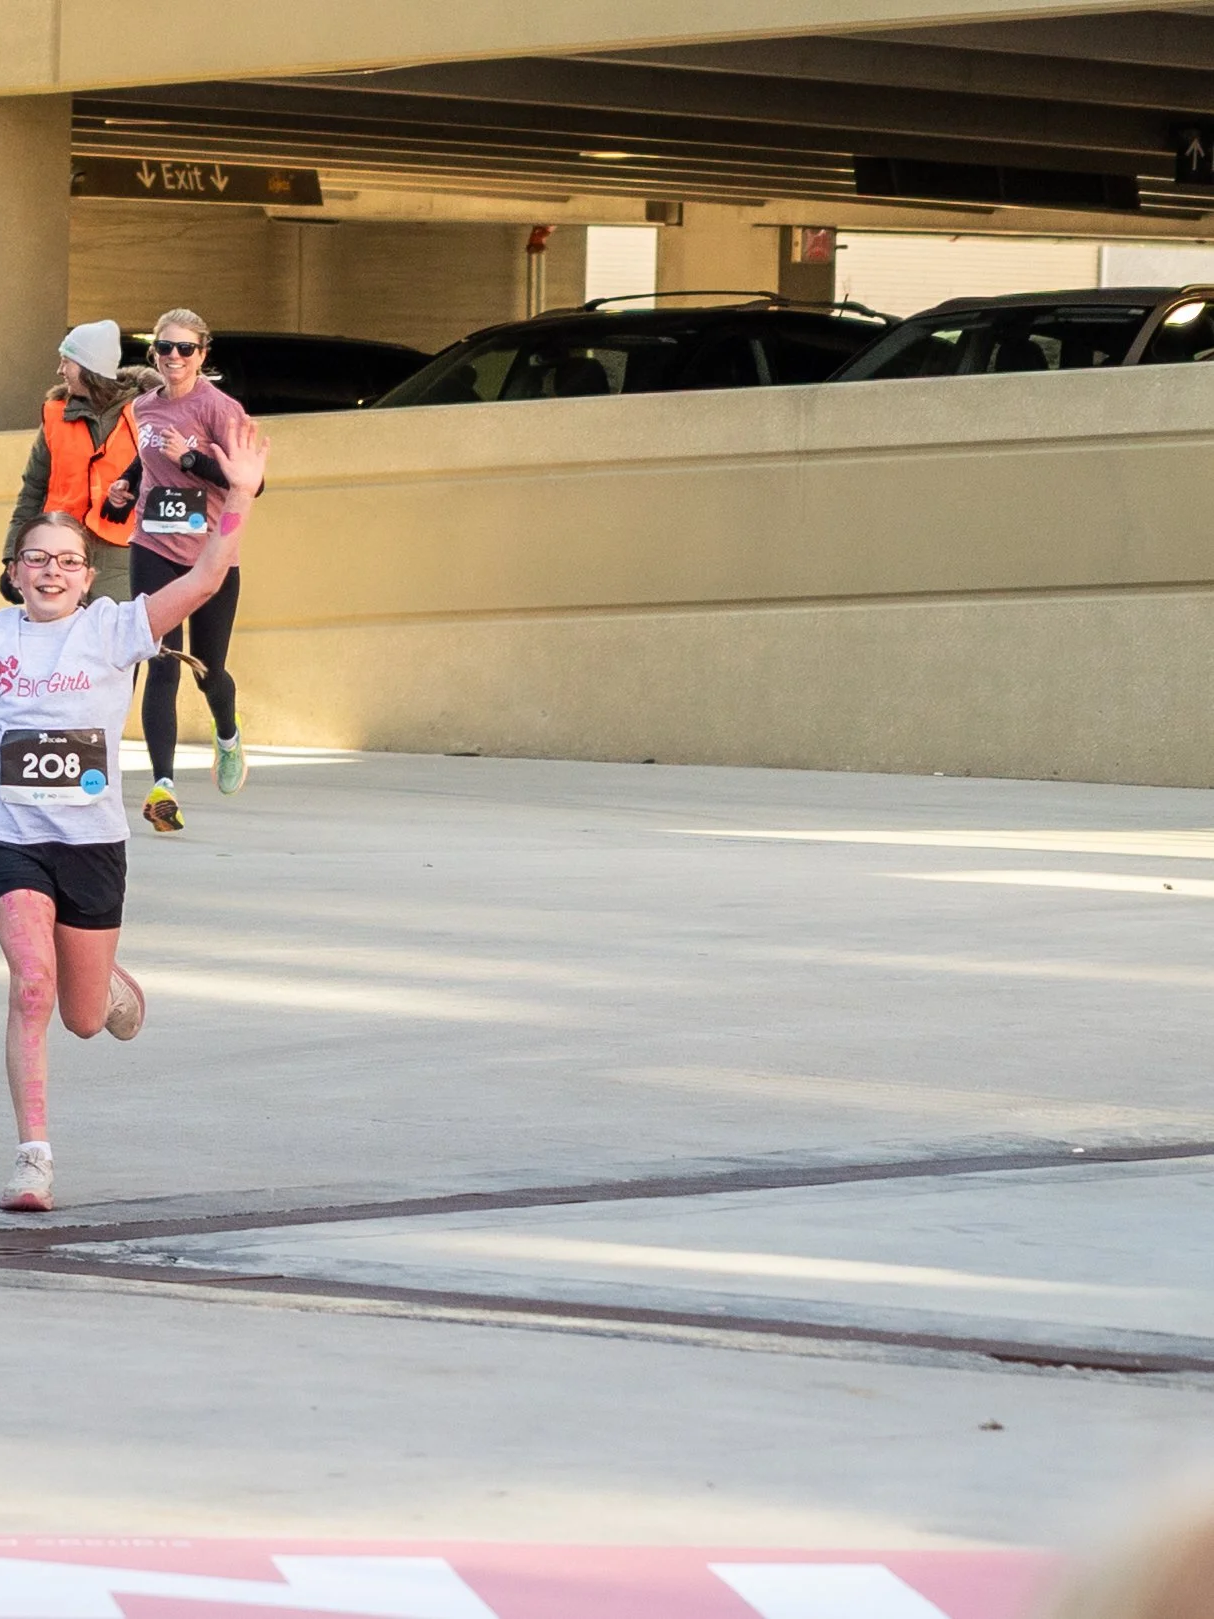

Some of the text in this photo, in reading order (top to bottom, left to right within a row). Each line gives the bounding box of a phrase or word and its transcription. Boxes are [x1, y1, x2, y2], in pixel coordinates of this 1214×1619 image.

[161, 162, 205, 191] Exit
[159, 501, 186, 518] 163
[22, 752, 80, 779] 208
